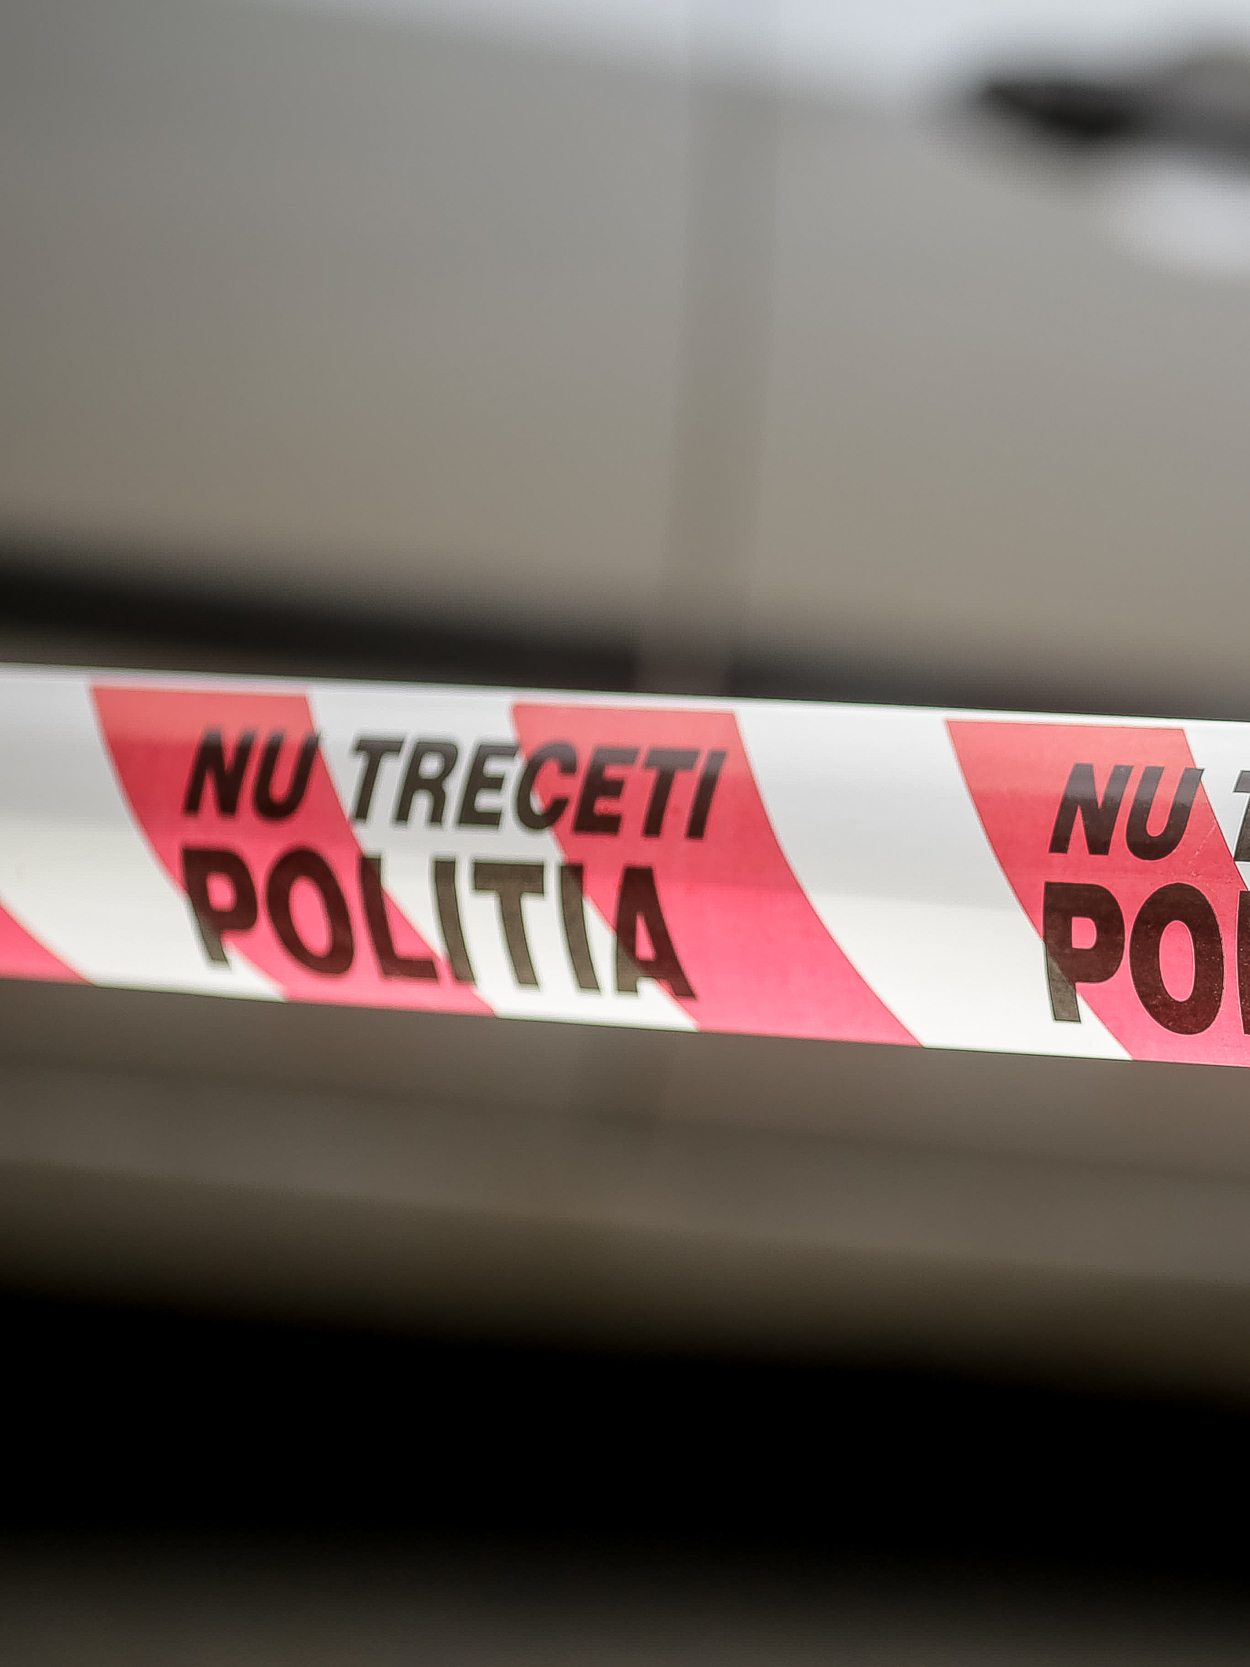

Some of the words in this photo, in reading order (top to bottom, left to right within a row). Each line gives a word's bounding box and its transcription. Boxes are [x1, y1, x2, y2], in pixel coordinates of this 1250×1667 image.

[183, 729, 320, 821] NU
[348, 738, 727, 841] TRECETI
[1048, 763, 1204, 861] NU
[183, 846, 698, 1001] POLITIA
